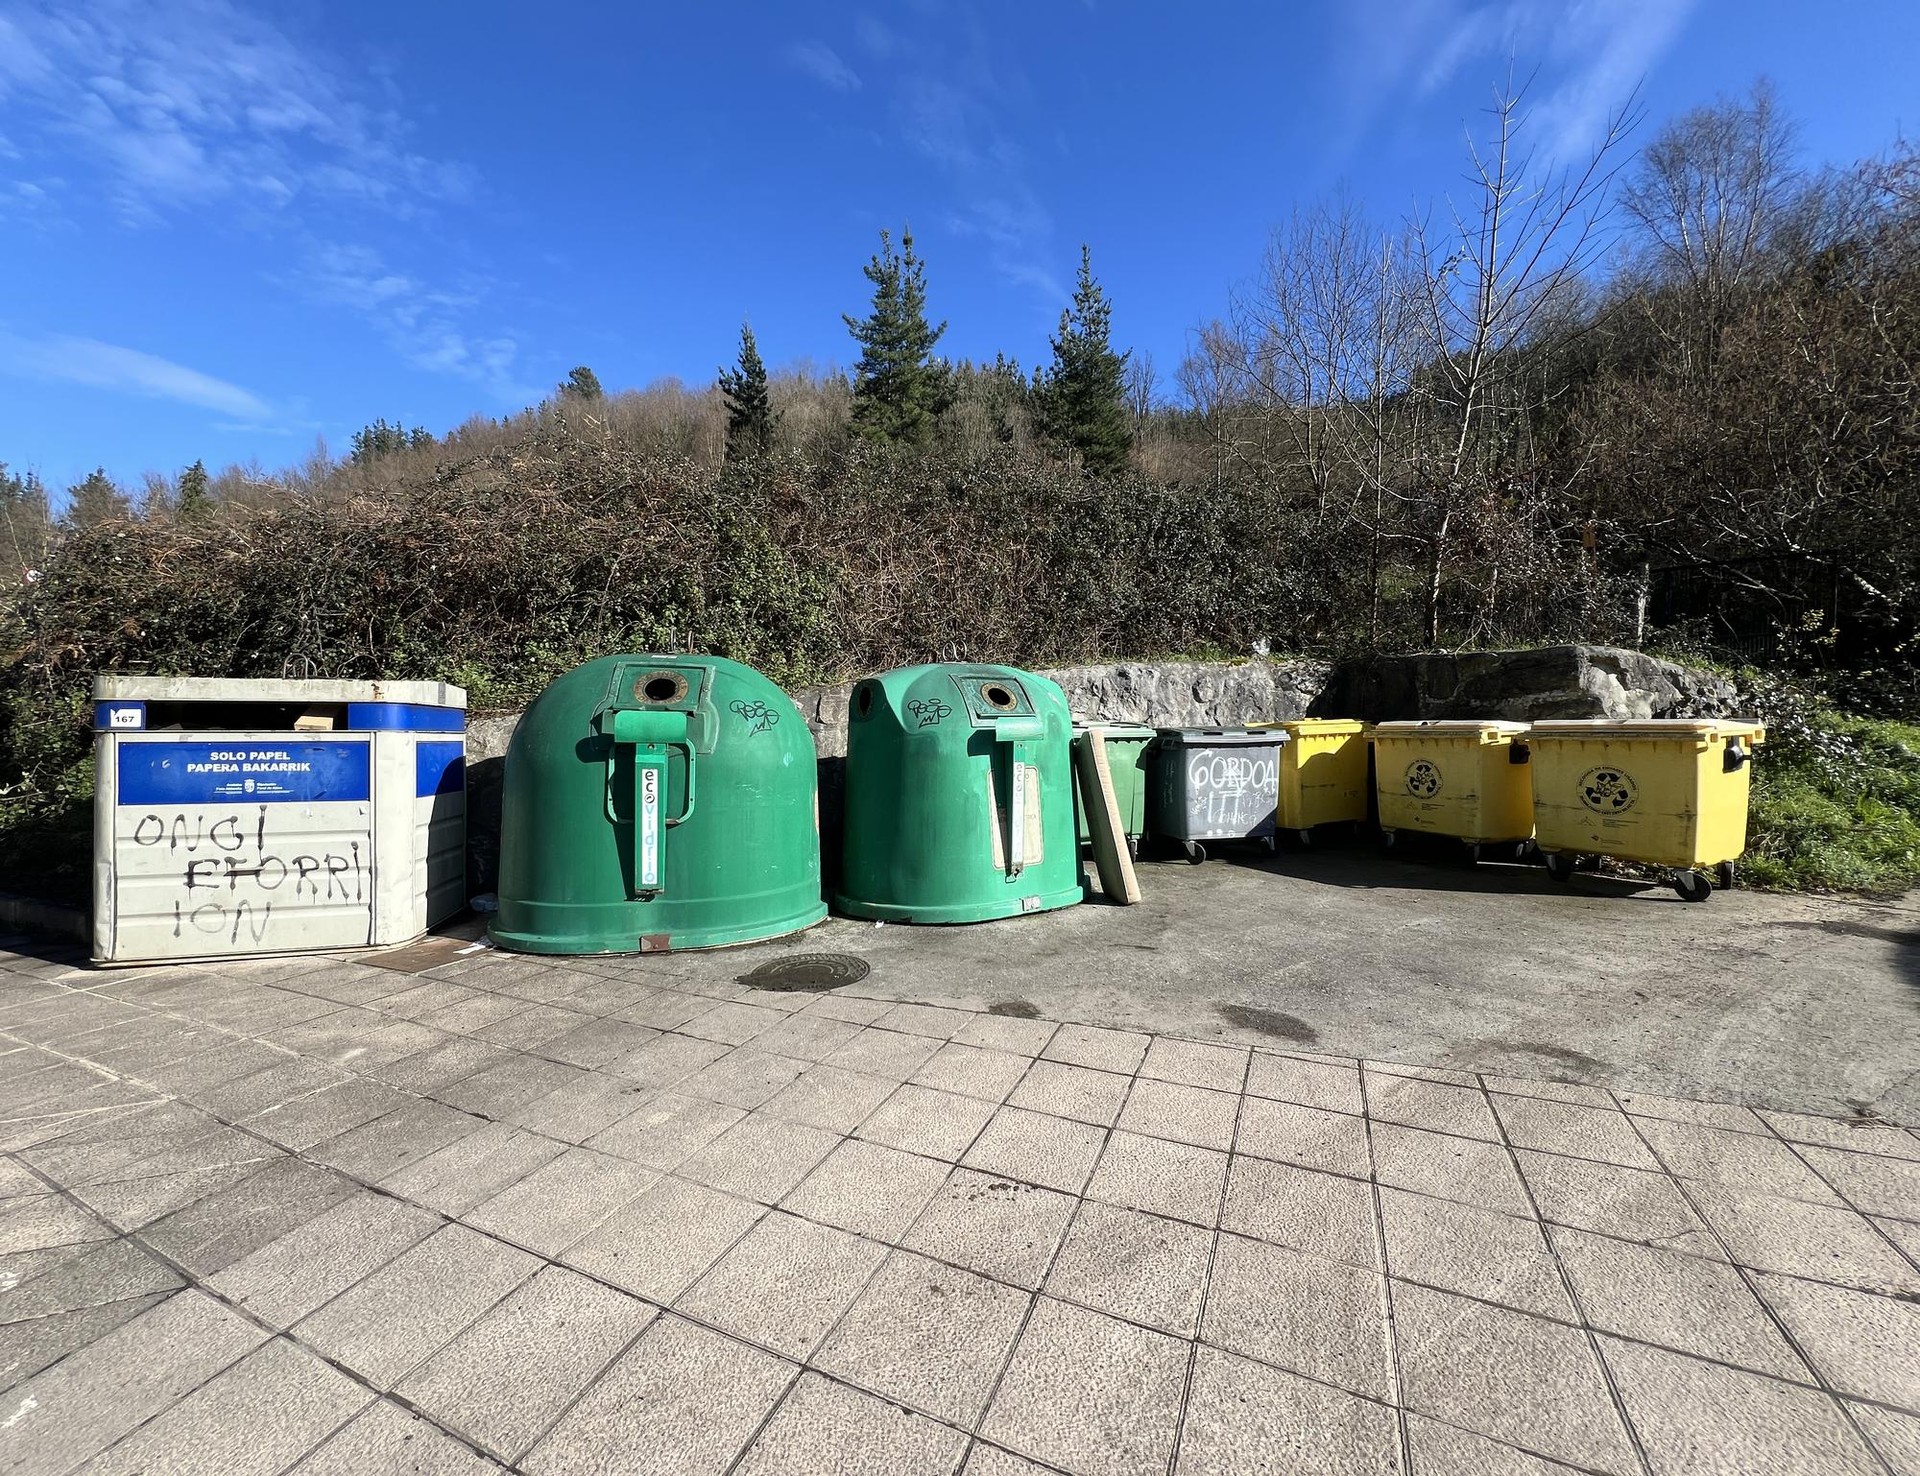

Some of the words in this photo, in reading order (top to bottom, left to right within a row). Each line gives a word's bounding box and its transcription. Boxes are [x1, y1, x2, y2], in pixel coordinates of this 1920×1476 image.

[210, 751, 247, 761] SOLO
[249, 751, 291, 761] PAPEL
[187, 763, 240, 773] PAPERA
[242, 762, 311, 772] BAKARRIK
[134, 804, 267, 856] ONGI
